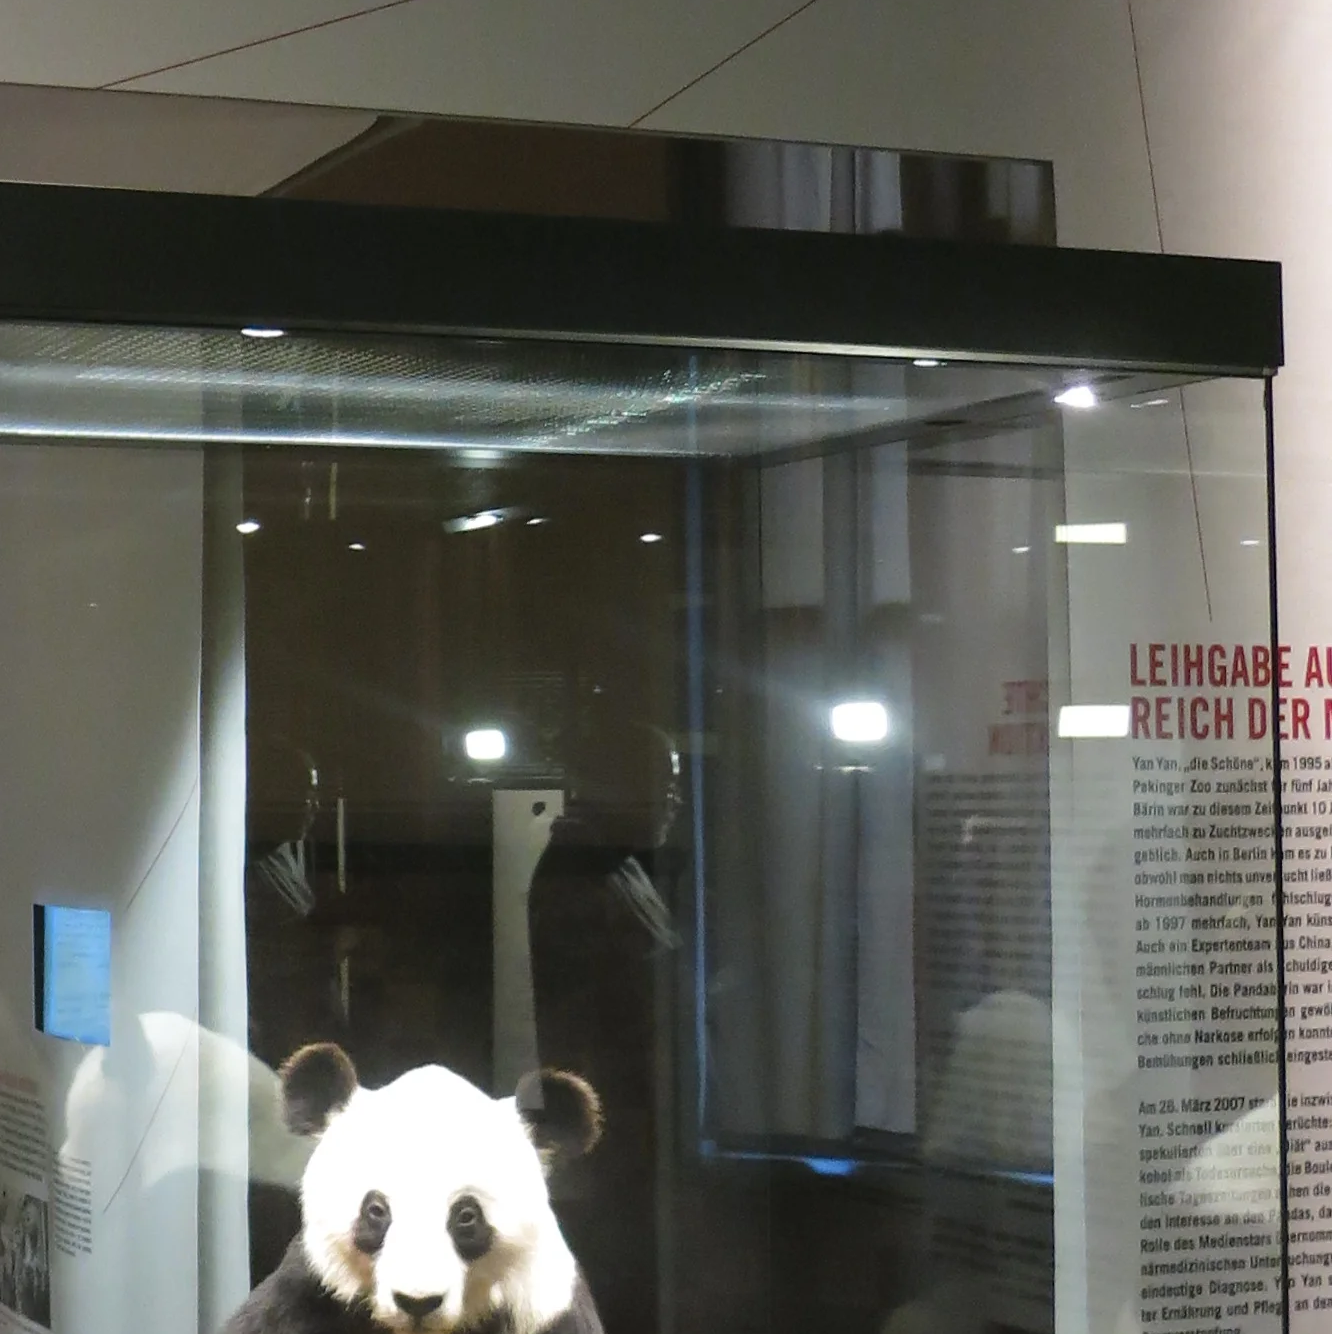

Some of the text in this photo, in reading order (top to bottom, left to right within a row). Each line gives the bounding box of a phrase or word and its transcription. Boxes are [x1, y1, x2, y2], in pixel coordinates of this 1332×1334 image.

[1129, 642, 1292, 688] LEIHGABE
[1131, 696, 1233, 740] REICH
[1131, 757, 1154, 771] Yan
[1292, 756, 1322, 770] 1995
[1133, 779, 1312, 796] Pekinger Zoo zunächst fünf
[1133, 801, 1326, 816] Bärin war zu diesem 10
[1133, 824, 1189, 839] mehrfach
[1185, 846, 1327, 861] Auch in Berlin es zu
[1134, 870, 1243, 885] obwohl man nichts
[1135, 892, 1263, 911] Hormonbehandlungen
[1191, 914, 1276, 933] mehrfach, Yan
[1136, 935, 1331, 956] Auch Expertenteam China
[1136, 960, 1273, 976] männlichen Partner als
[1137, 982, 1324, 1003] schlug Die war
[1137, 1007, 1205, 1023] künstlichen
[1194, 1028, 1243, 1043] Narkose
[1137, 1052, 1213, 1071] Bemühungen
[1138, 1100, 1156, 1114] Am
[1181, 1098, 1211, 1113] März
[1213, 1096, 1245, 1111] 2007
[1166, 1120, 1211, 1136] Schnell
[1165, 1211, 1220, 1228] Interesse
[1173, 1231, 1271, 1250] des Medienstars
[1141, 1256, 1246, 1275] närmedizinischen
[1142, 1273, 1322, 1303] eindeutige Diagnose. Yan
[1161, 1301, 1249, 1324] Ernährung und
